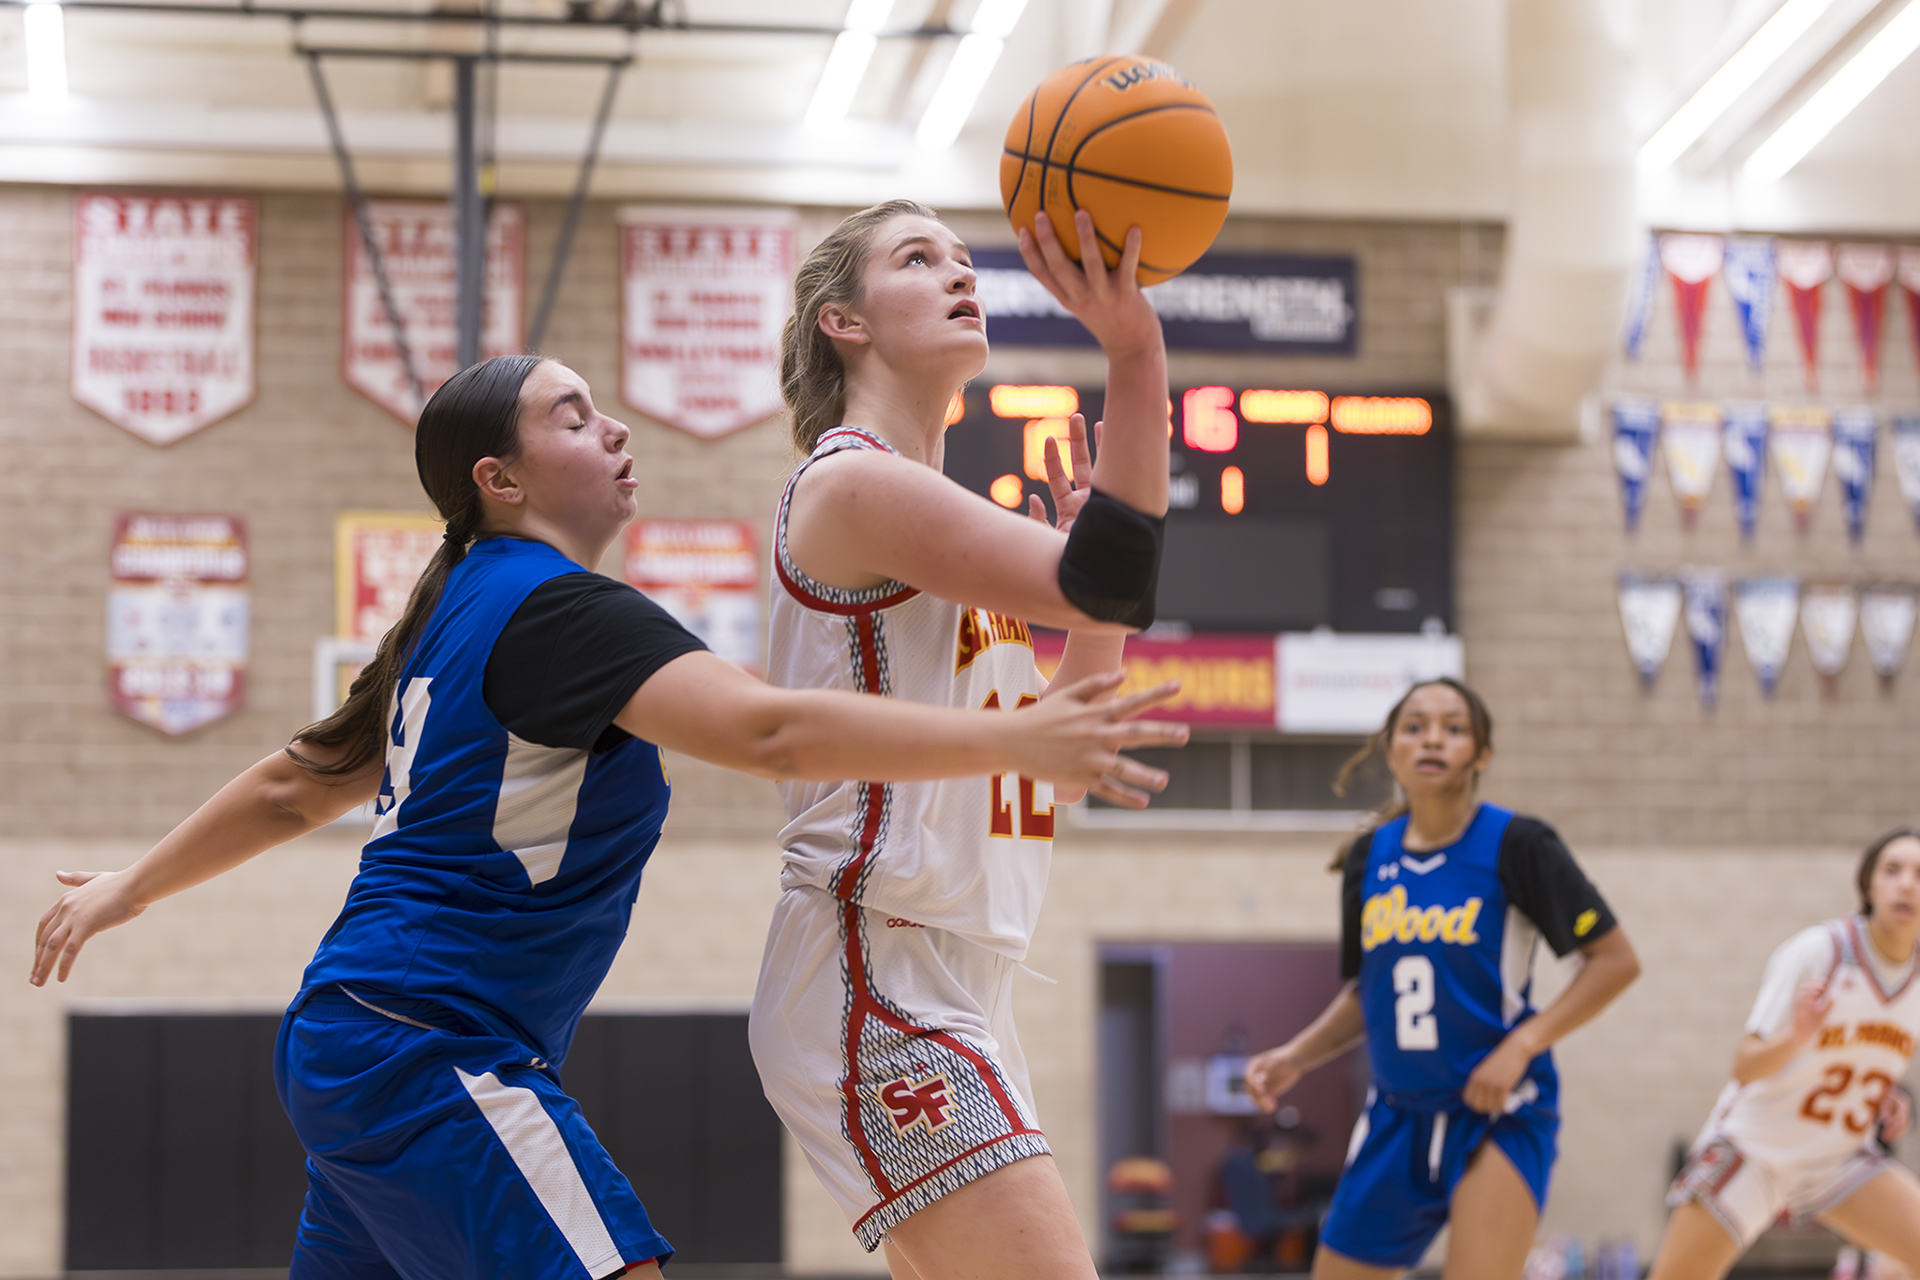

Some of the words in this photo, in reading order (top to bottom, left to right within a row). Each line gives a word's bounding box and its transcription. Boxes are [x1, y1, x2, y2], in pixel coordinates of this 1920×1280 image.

[84, 199, 246, 236] STATE
[1360, 883, 1484, 952] Wood
[1391, 954, 1440, 1052] 2
[877, 1071, 959, 1139] SF
[1798, 1062, 1894, 1135] 23
